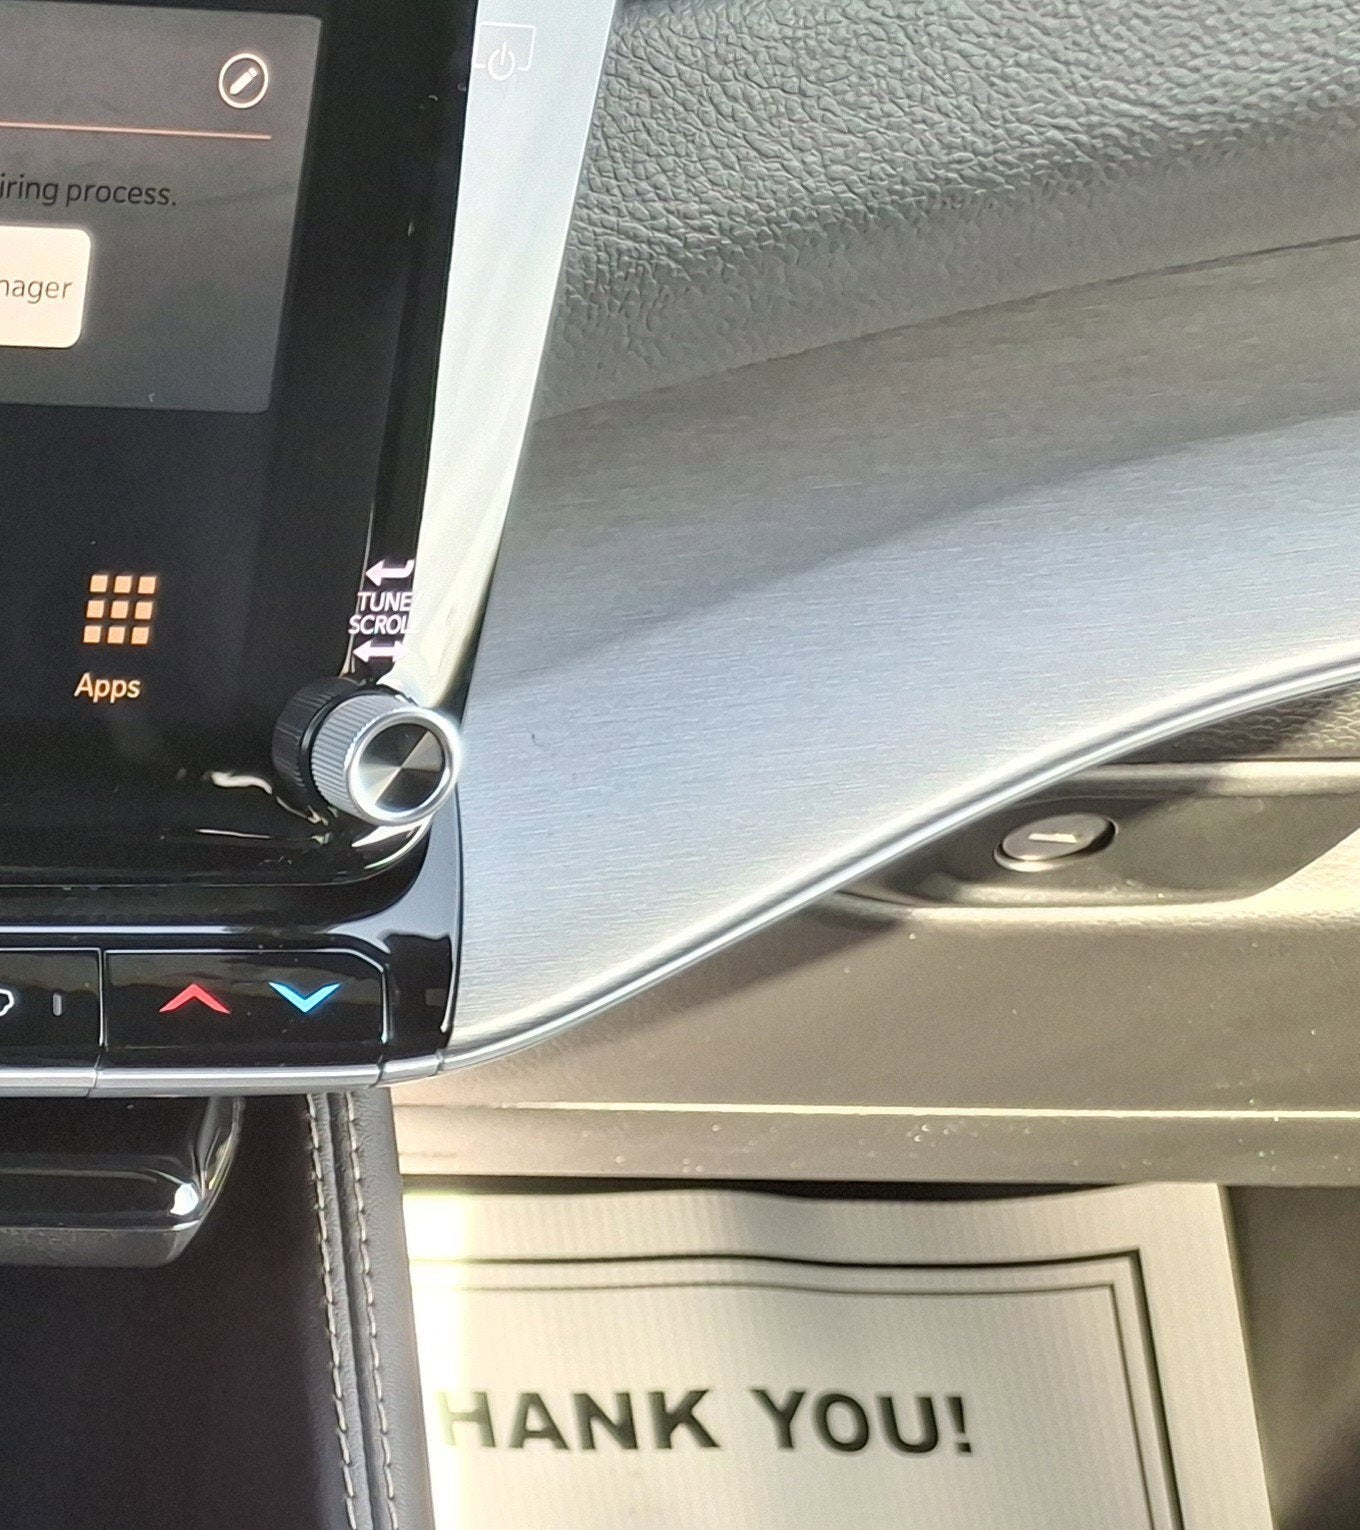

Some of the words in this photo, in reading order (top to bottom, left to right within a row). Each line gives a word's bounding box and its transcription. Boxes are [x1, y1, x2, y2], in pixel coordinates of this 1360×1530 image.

[66, 182, 177, 207] process.
[74, 672, 141, 705] Apps
[439, 1388, 720, 1450] HANK
[750, 1386, 974, 1456] YOU!
